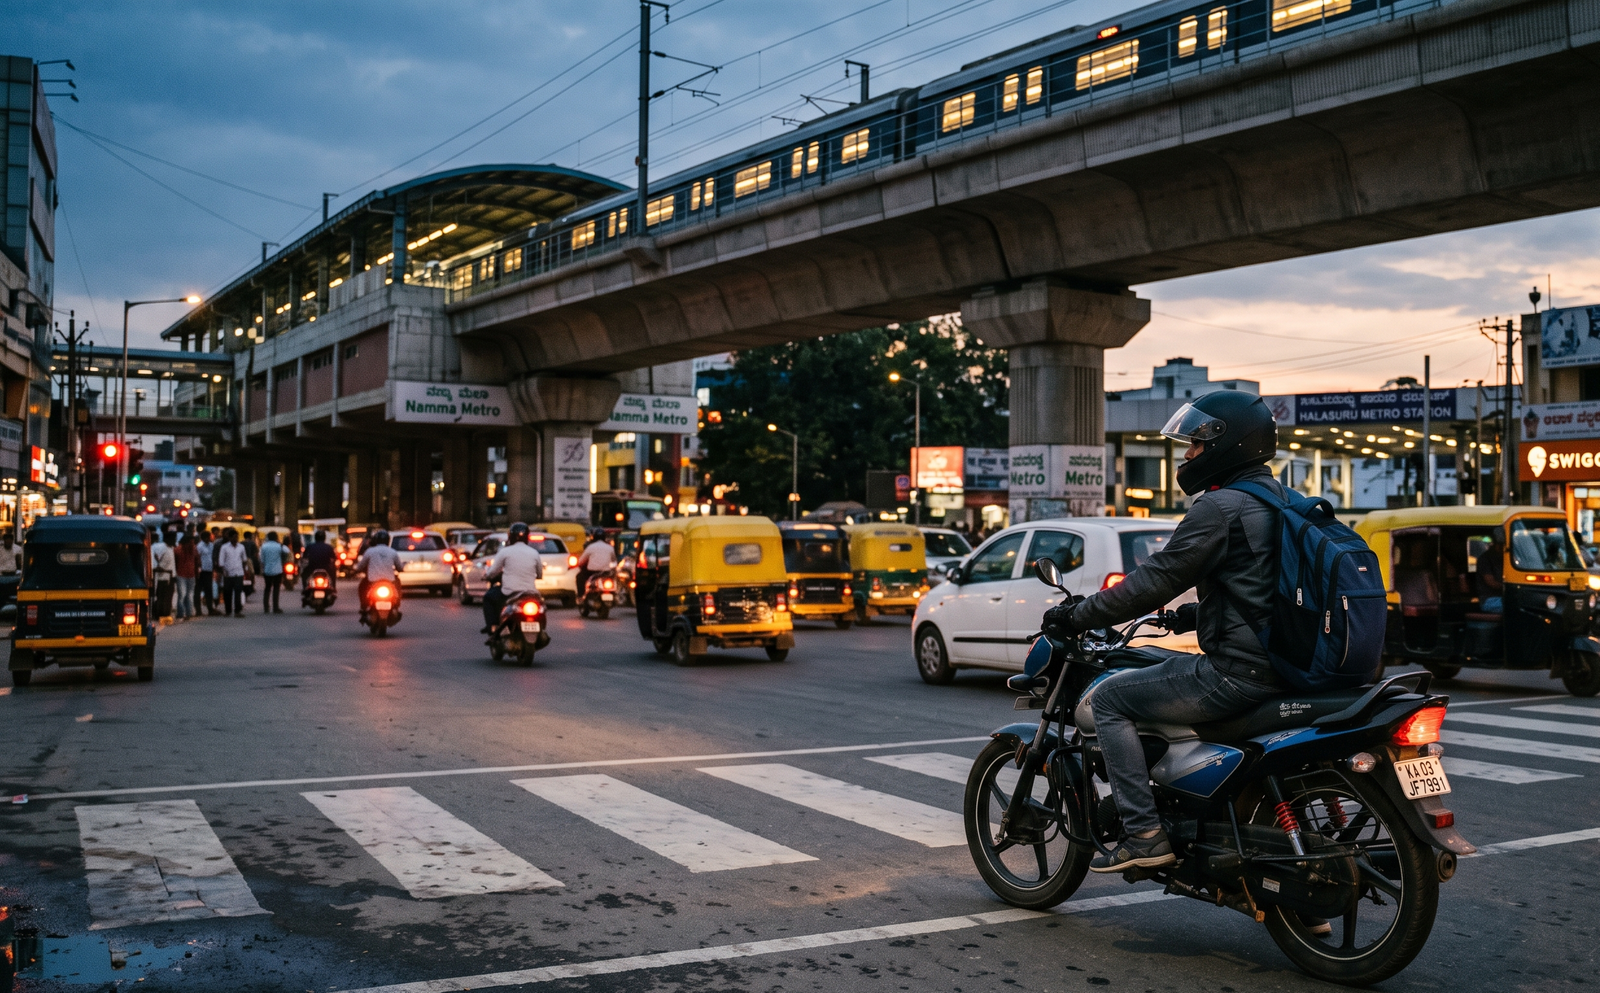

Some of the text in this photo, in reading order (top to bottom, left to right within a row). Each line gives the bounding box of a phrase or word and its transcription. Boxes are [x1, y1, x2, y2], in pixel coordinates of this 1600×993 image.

[406, 400, 500, 417] Namma Metro
[1300, 406, 1451, 421] HALASURU METRO STAION
[653, 413, 688, 425] Metro
[1065, 470, 1103, 486] Metro
[1405, 760, 1435, 779] KA 03
